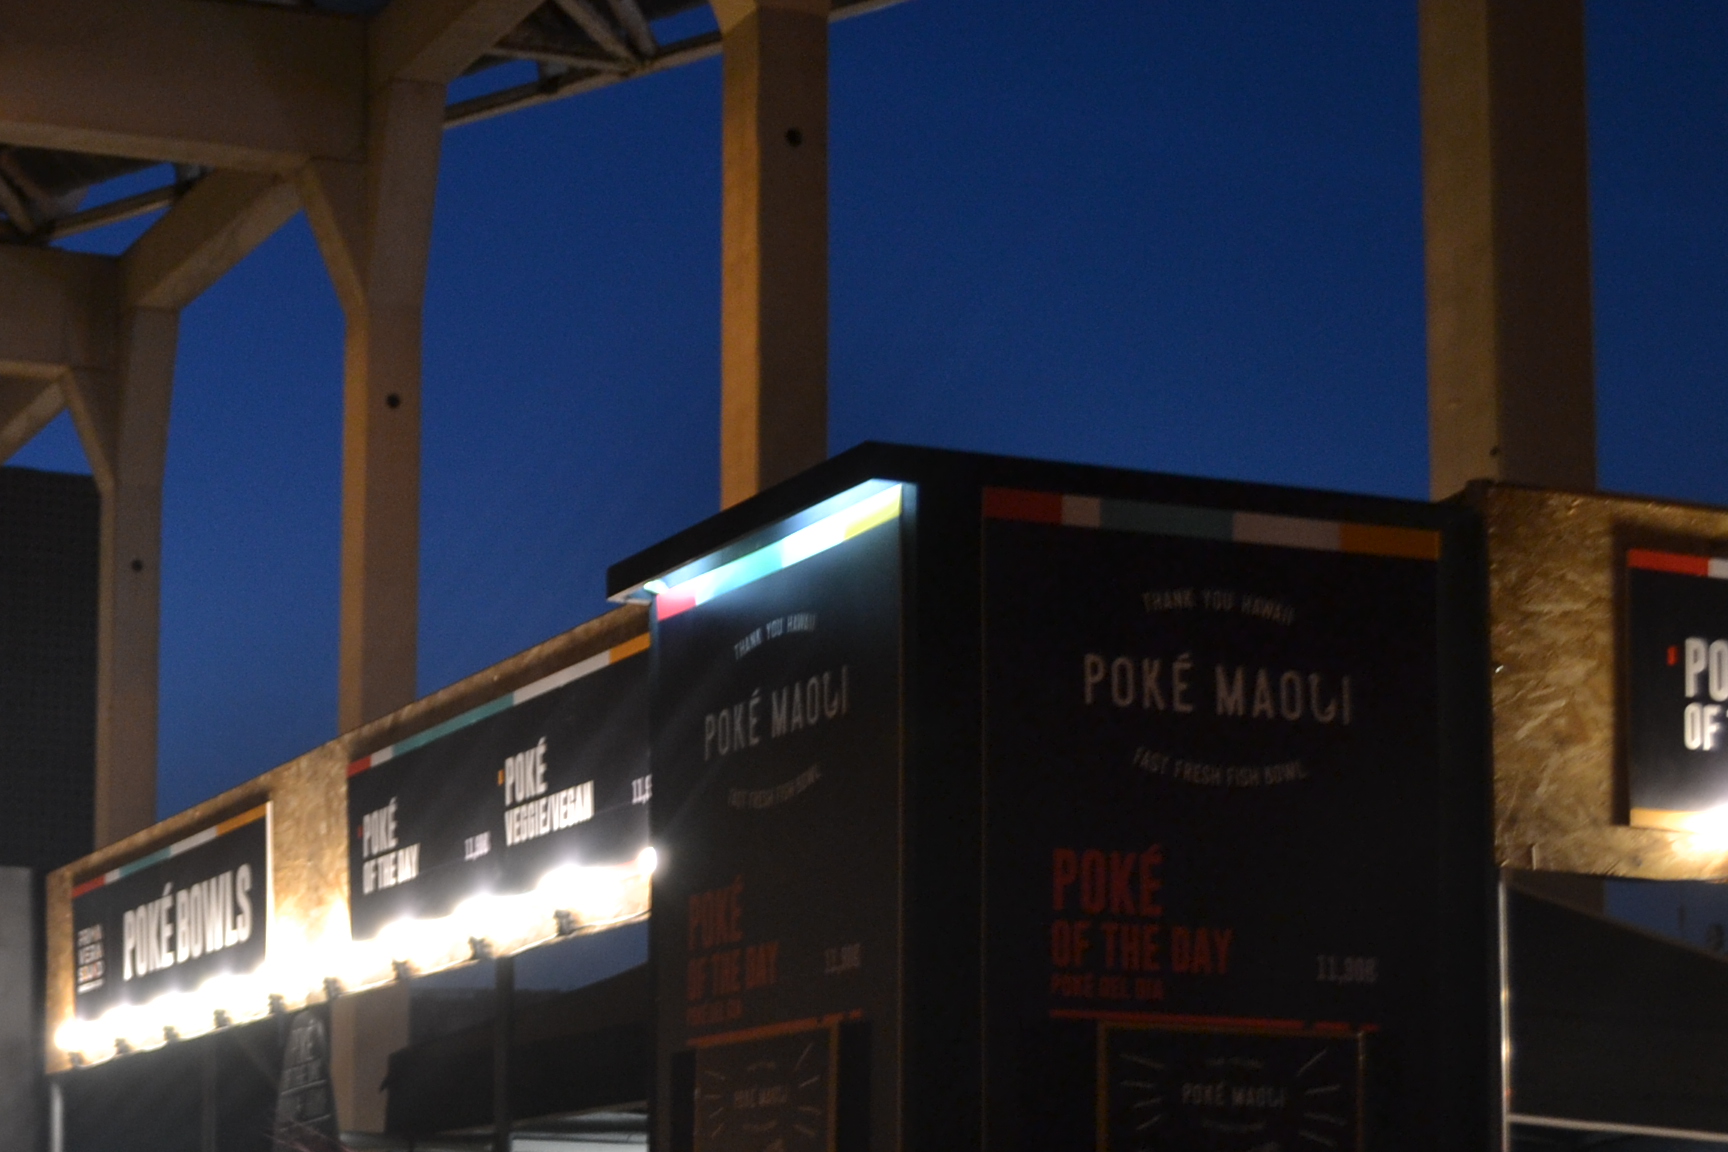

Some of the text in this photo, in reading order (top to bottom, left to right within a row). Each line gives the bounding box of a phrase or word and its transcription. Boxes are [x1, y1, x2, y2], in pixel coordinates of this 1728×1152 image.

[1142, 587, 1196, 613] THANK
[1202, 587, 1234, 611] YOU
[1082, 650, 1196, 715] POKÉ
[704, 687, 762, 762] POKÉ
[1683, 702, 1721, 751] OF
[504, 736, 548, 807] POKÉ
[1132, 745, 1169, 775] FAST
[1173, 758, 1221, 787] FRESH
[1226, 765, 1261, 788] FISH
[362, 796, 398, 858] POKÉ
[504, 780, 595, 847] VEGGIE/VEGAN
[362, 843, 420, 895] OF THE DAY
[1051, 843, 1166, 918] POKÉ
[123, 863, 252, 982] POKÉ BOWLS
[688, 873, 744, 950] POKÉ
[687, 956, 708, 1000] OF
[711, 948, 742, 996] THE
[1050, 918, 1235, 975] OF THE DAY
